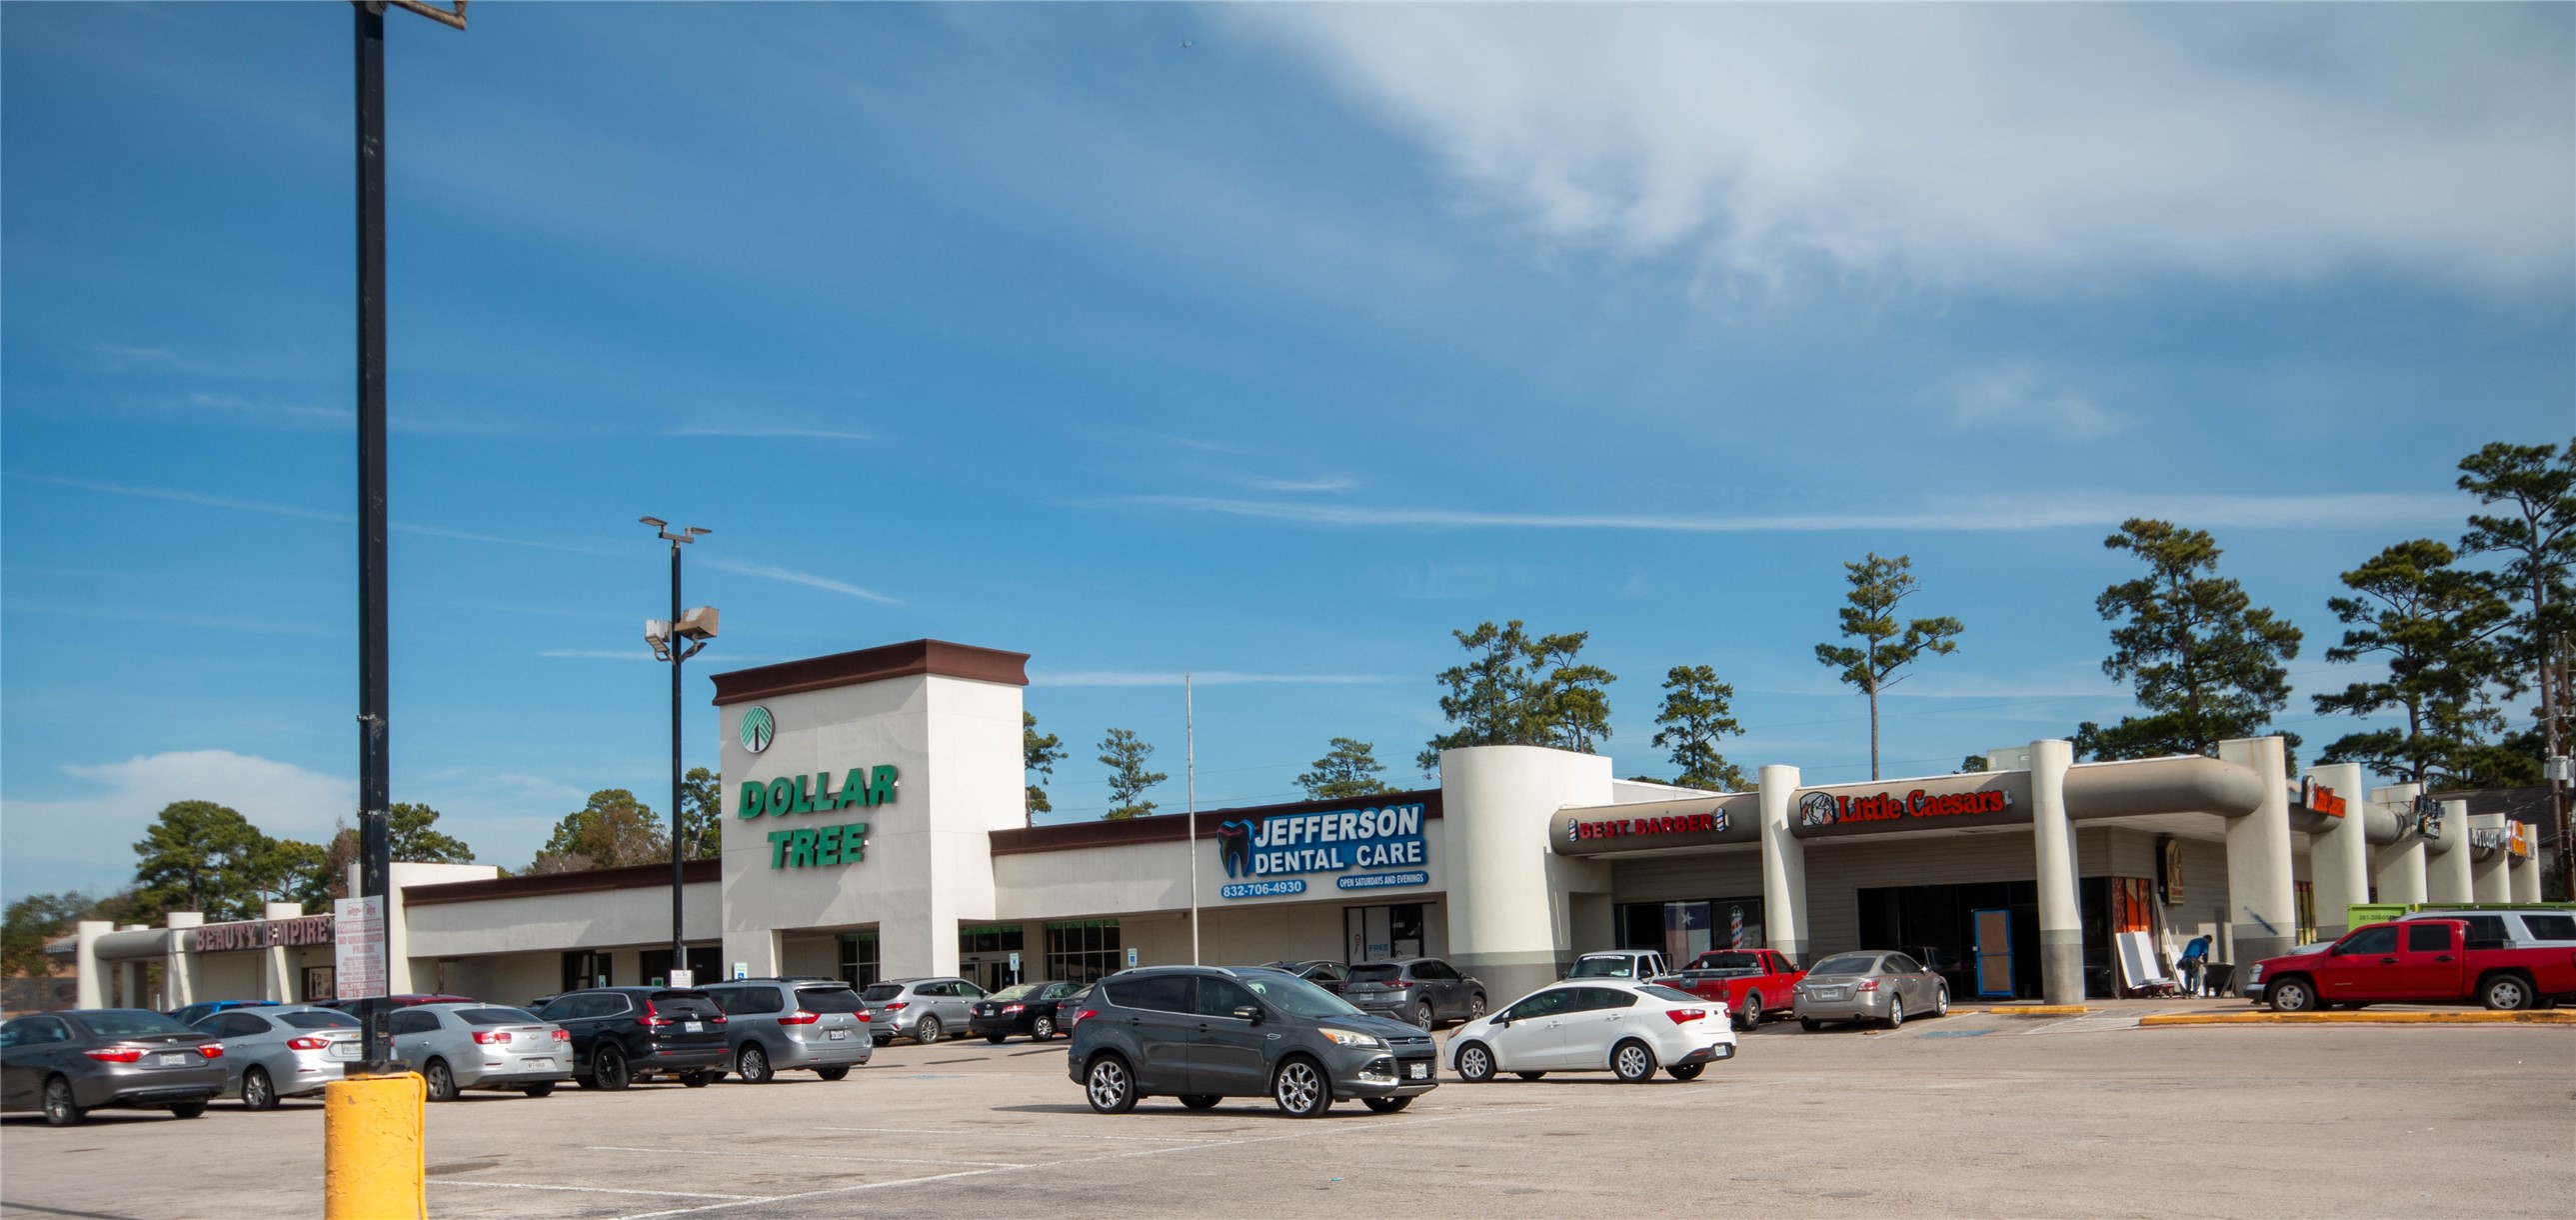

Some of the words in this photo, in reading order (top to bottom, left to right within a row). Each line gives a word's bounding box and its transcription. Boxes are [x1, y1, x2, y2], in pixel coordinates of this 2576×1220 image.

[738, 764, 899, 820] DOLLAR
[1835, 792, 1901, 823] Little
[1906, 789, 2005, 818] Caesars
[1255, 807, 1419, 848] JEFFERSON
[1579, 819, 1629, 839] BEST
[1634, 813, 1713, 836] BARBER
[768, 823, 868, 870] TREE
[1255, 847, 1343, 874] DENTAL
[1356, 841, 1421, 867] CARE
[1223, 881, 1302, 897] 832-706-4930
[1339, 876, 1354, 888] OPEN
[1354, 874, 1383, 887] SATURDAYS
[1384, 874, 1396, 885] AND
[1396, 873, 1423, 885] EVENINGS
[195, 923, 256, 951] BEAUTY
[266, 917, 327, 946] EMPIRE
[1368, 944, 1388, 952] FREE
